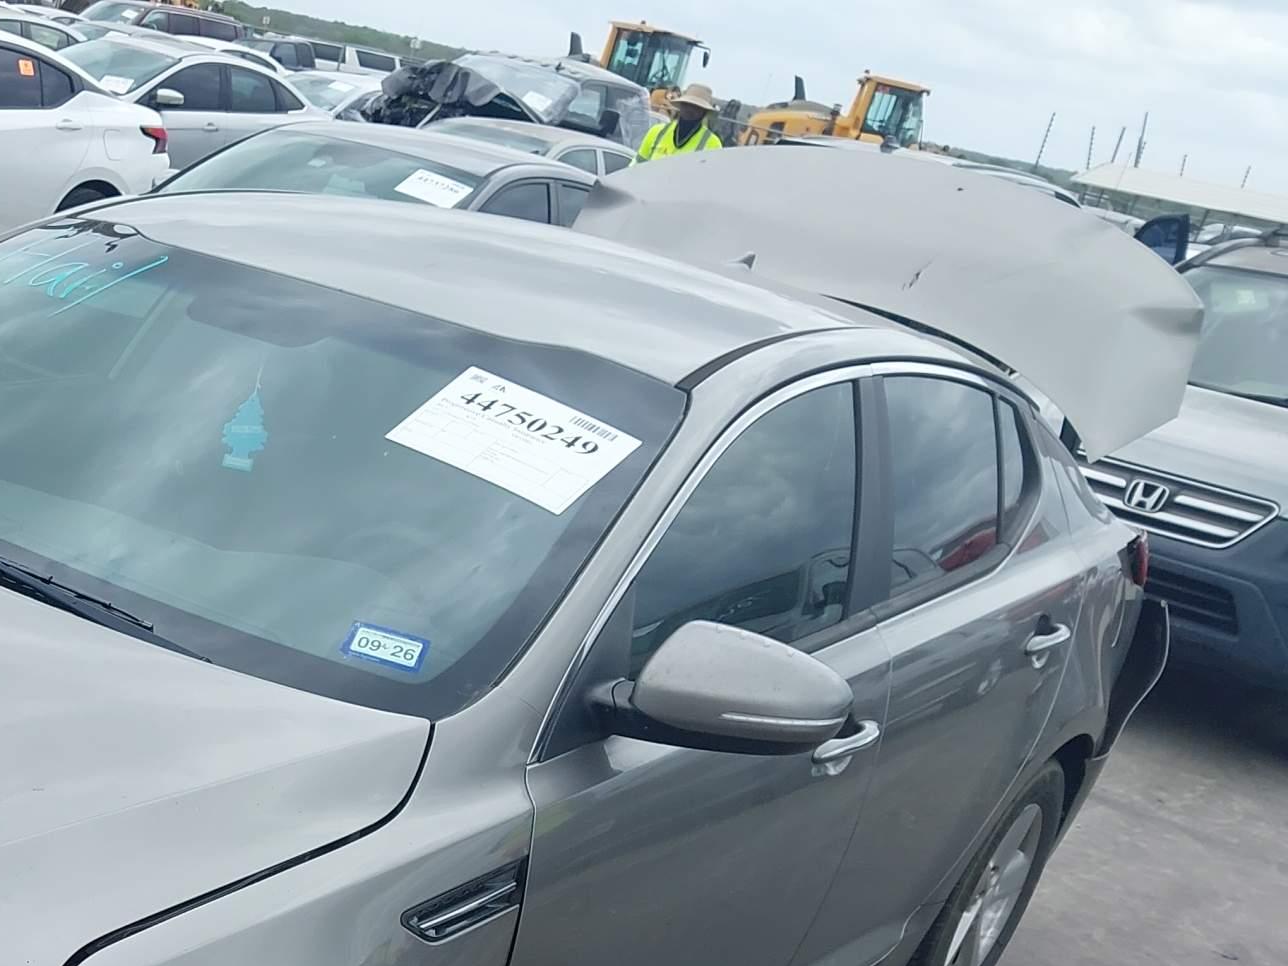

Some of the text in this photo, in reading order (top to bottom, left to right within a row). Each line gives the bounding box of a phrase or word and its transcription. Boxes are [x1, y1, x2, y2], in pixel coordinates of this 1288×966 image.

[460, 391, 599, 455] 44750249
[357, 636, 416, 661] 09 26
